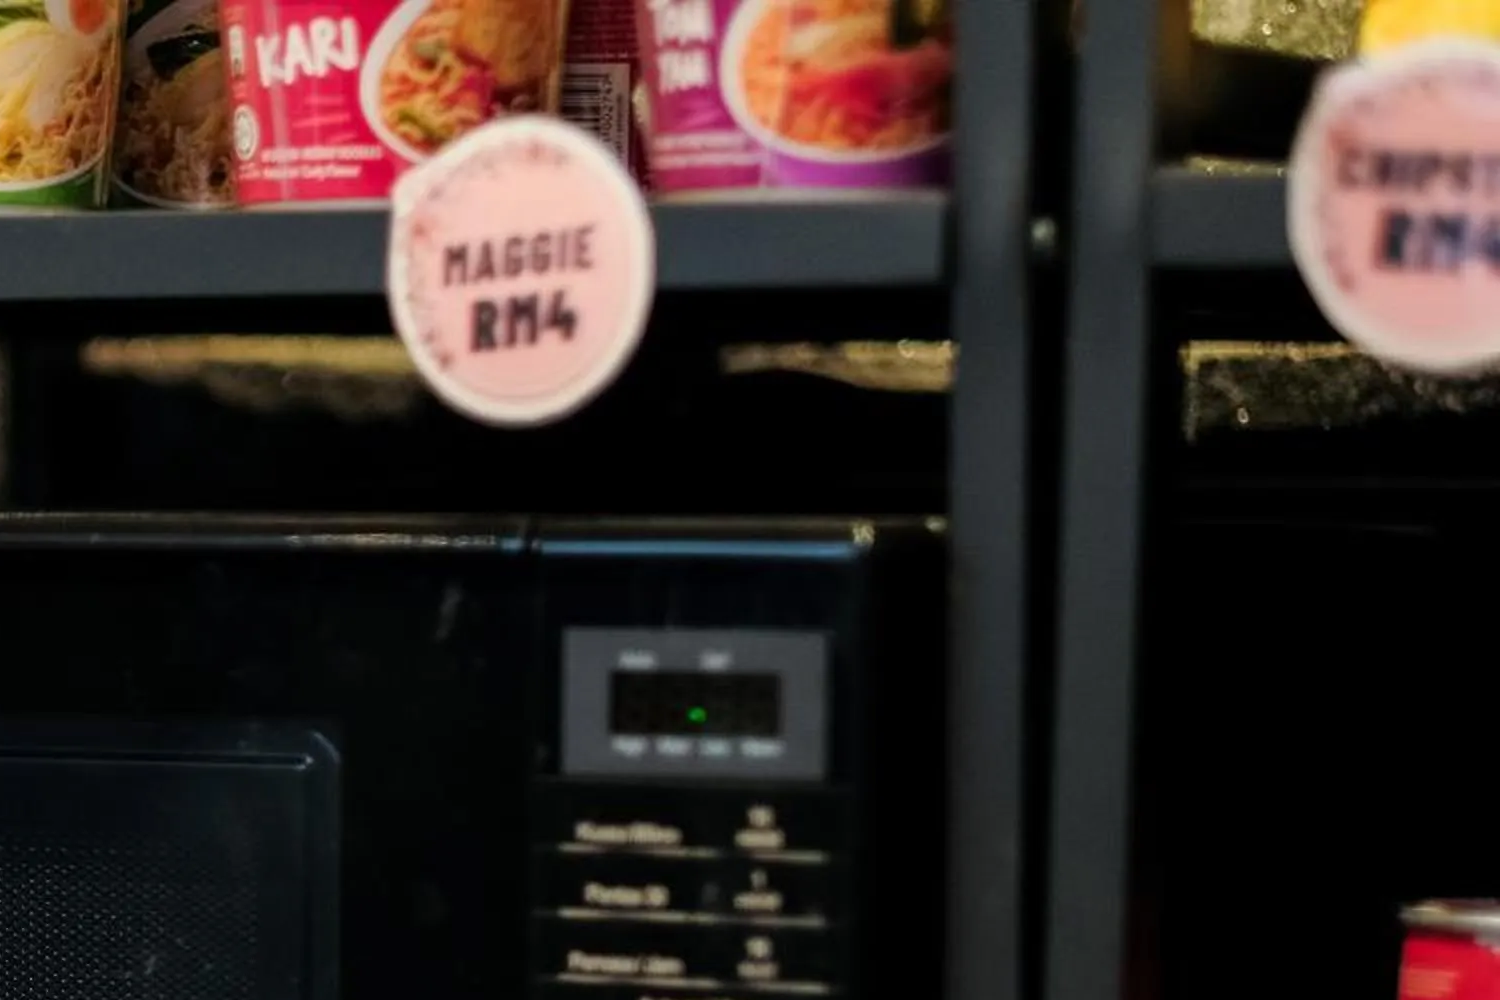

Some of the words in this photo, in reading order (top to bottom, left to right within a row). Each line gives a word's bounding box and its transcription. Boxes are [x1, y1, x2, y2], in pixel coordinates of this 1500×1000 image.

[255, 15, 360, 88] KARI
[444, 224, 596, 286] MAGGIE
[469, 289, 578, 353] RM4
